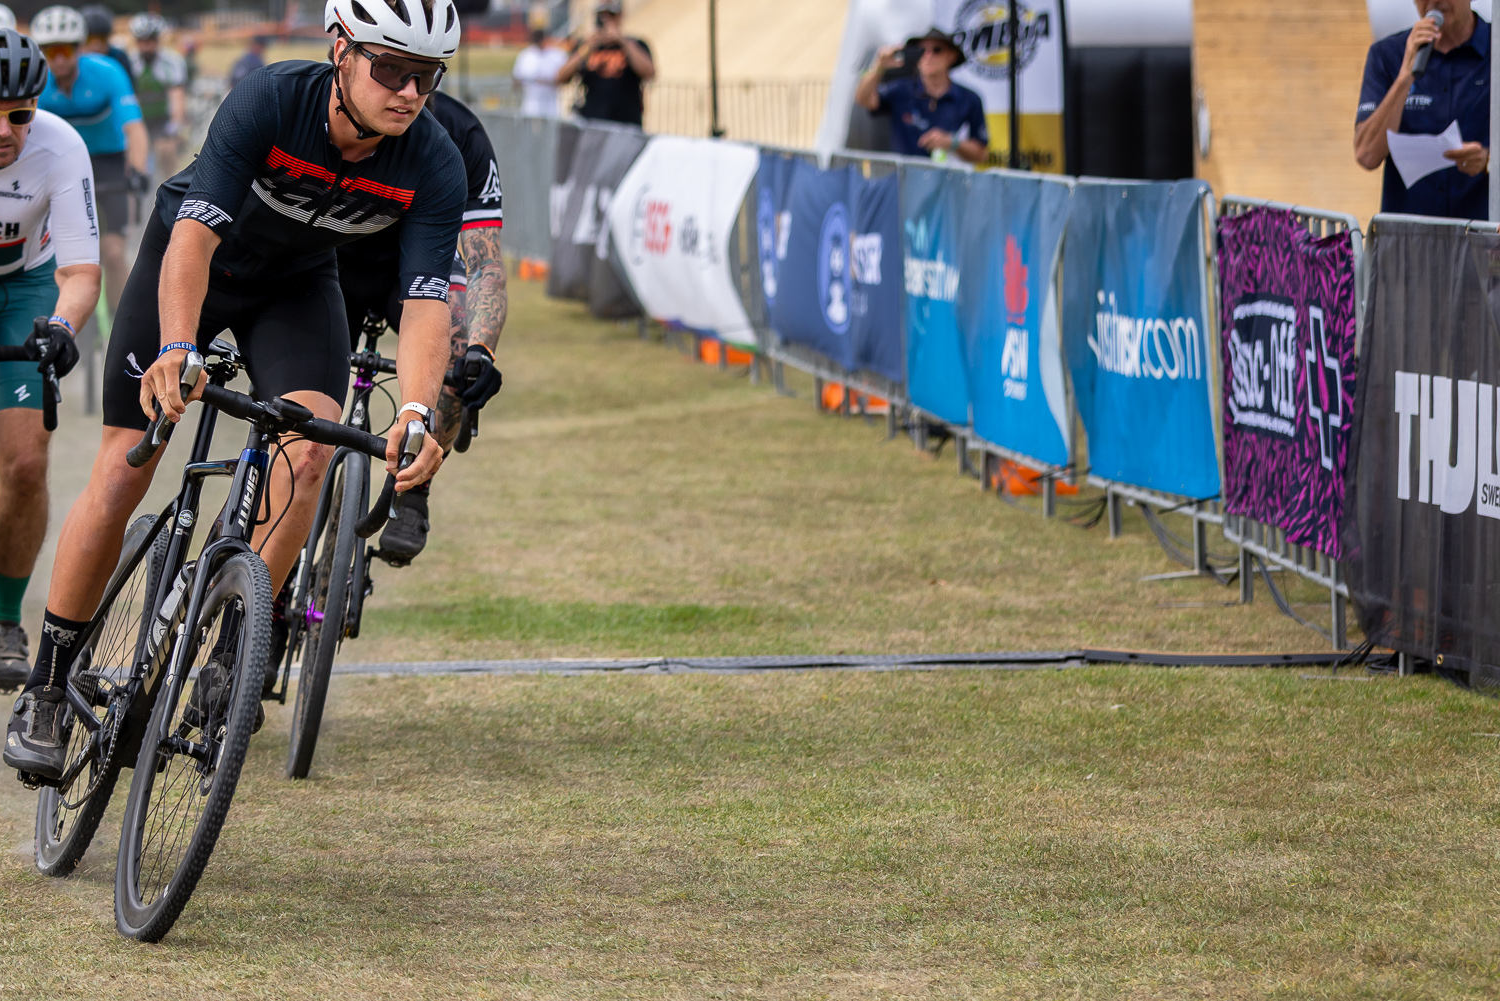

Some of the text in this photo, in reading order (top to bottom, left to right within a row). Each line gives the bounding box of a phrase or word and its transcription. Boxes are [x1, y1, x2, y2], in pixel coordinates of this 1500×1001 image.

[166, 342, 193, 351] ATHLETE
[237, 464, 260, 536] GIANT
[43, 620, 79, 648] FOX
